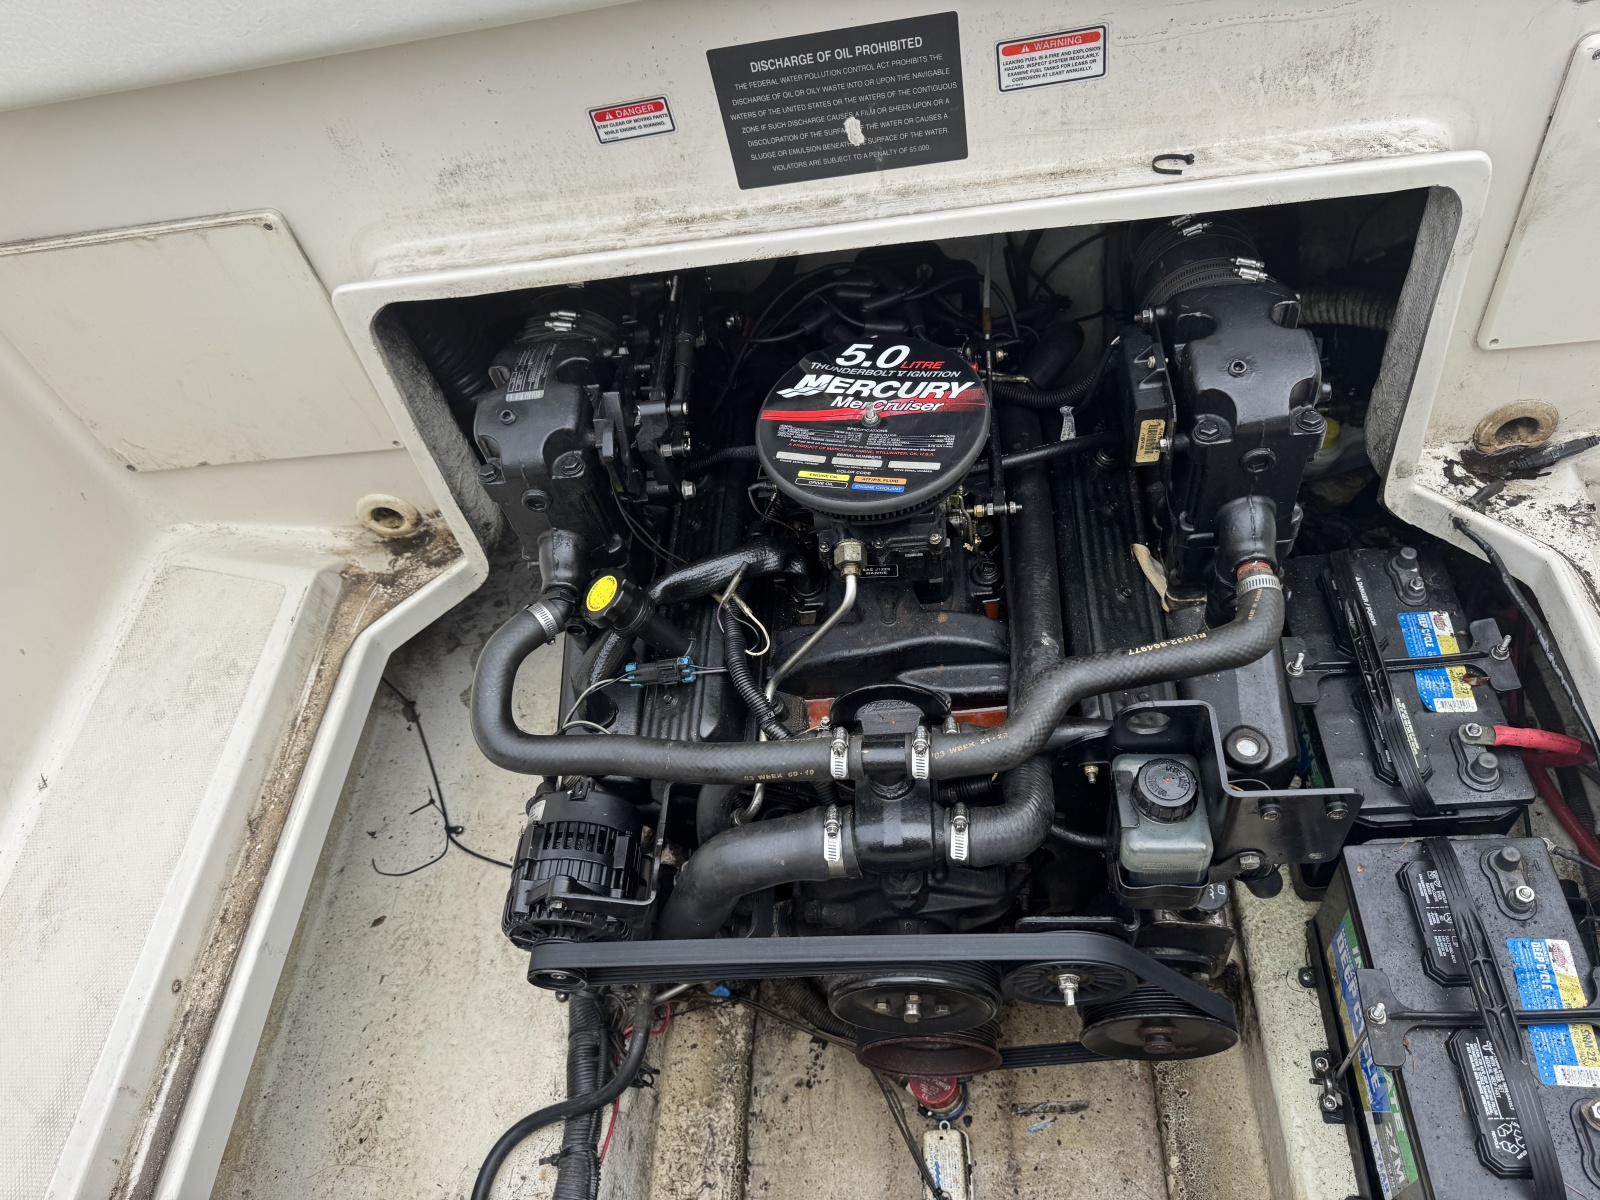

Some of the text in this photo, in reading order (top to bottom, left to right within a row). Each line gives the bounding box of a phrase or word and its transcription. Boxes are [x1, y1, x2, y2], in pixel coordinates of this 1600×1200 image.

[750, 36, 923, 72] DISCHARGE OF OIL PROHIBITED
[1034, 36, 1082, 50] WARNING
[1069, 52, 1100, 62] REGULARLY.
[1072, 46, 1101, 55] EXPLOSION
[749, 79, 779, 88] FEDERAL
[780, 74, 803, 84] WATER
[804, 69, 842, 80] POLLUTION
[843, 64, 875, 74] CONTROL
[877, 61, 889, 70] ACT
[892, 55, 928, 67] PROHIBITS
[929, 53, 943, 61] THE
[1012, 74, 1040, 82] CORROSION
[1066, 66, 1092, 74] ANNUALLY.
[730, 111, 757, 121] WATERS
[782, 104, 806, 113] UNITED
[808, 100, 832, 110] STATES
[858, 92, 886, 102] WATERS
[913, 82, 957, 94] CONTIGUOUS
[732, 94, 771, 106] DISCHARGE
[806, 87, 820, 95] OILY
[822, 83, 845, 93] WASTE
[847, 80, 863, 89] INTO
[876, 76, 896, 85] UPON
[912, 68, 950, 79] NAVIGABLE
[615, 104, 655, 118] DANGER
[742, 125, 760, 134] ZONE
[768, 122, 786, 130] SUCH
[788, 116, 825, 127] DISCHARGE
[826, 112, 853, 122] CAUSES
[888, 103, 911, 112] SHEEN
[913, 100, 932, 109] UPON
[748, 134, 798, 147] DISCOLORATION
[915, 114, 942, 123] CAUSES
[751, 151, 776, 161] SLUDGE
[789, 145, 821, 156] EMULSION
[823, 142, 852, 151] BENEATH
[868, 134, 897, 144] SURFACE
[925, 127, 949, 136] WATER.
[772, 161, 807, 172] VIOLATORS
[823, 155, 852, 164] SUBJECT
[869, 149, 897, 158] PENALTY
[810, 362, 894, 377] THUNDERBOLT
[835, 343, 945, 369] 5.0 LITRE
[794, 374, 976, 399] MERCURY
[830, 396, 945, 411] MerCruiser
[1357, 582, 1369, 602] DANGER
[1366, 607, 1377, 626] POISON
[949, 742, 976, 754] WEEK
[1336, 934, 1358, 998] DEEP
[1531, 942, 1541, 964] DEEP
[1537, 964, 1553, 990] CYCLE
[1385, 1122, 1406, 1183] 27M
